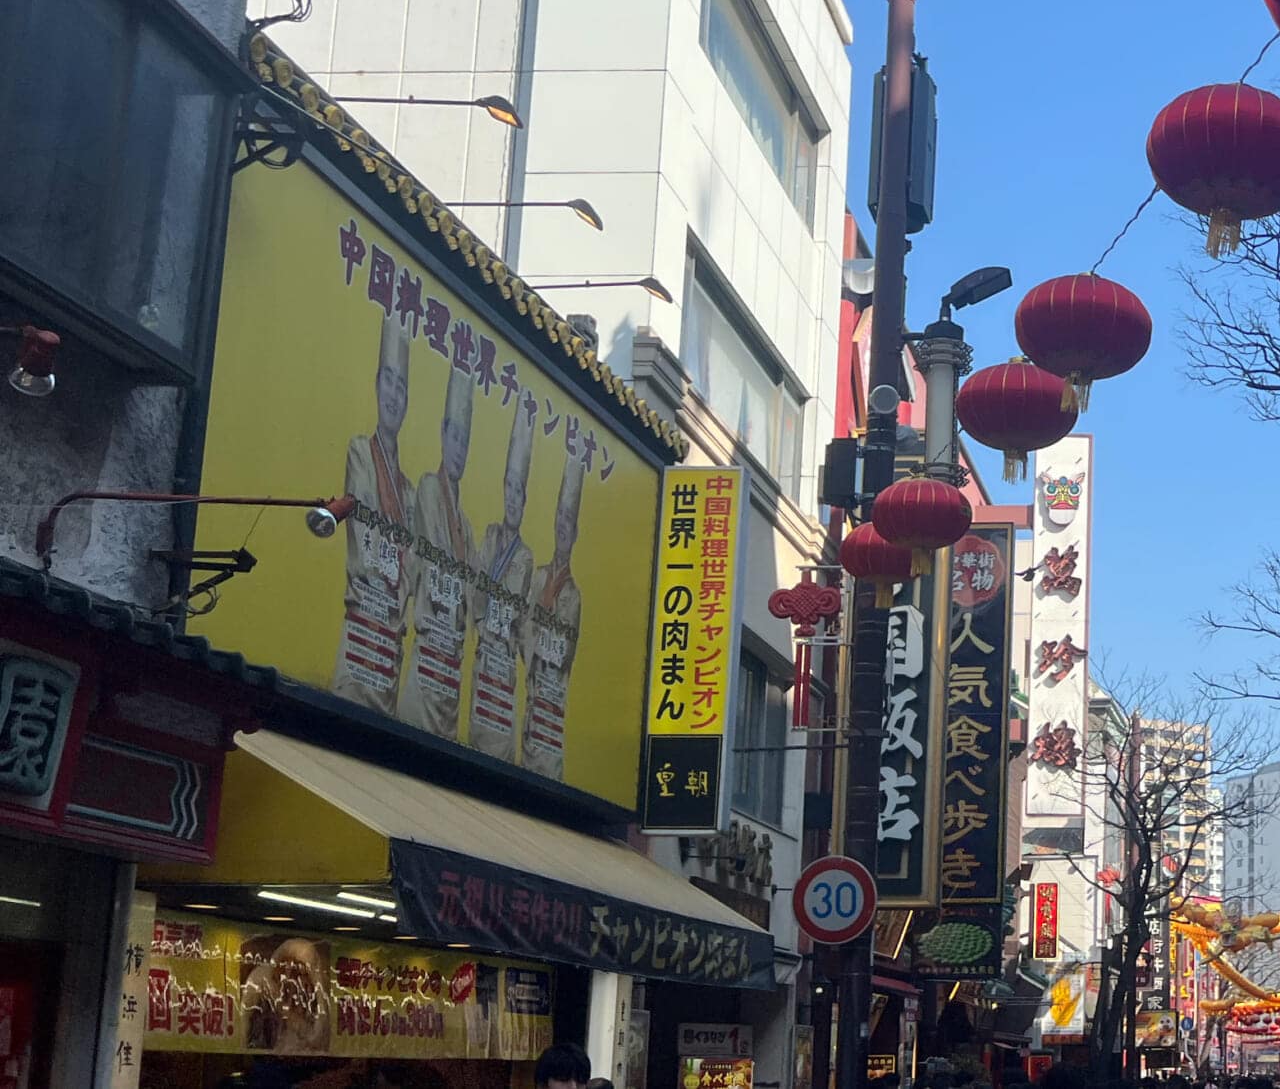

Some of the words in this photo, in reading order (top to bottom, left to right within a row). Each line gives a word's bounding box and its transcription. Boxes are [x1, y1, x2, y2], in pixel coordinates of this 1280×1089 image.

[339, 219, 615, 481] 中国料理世界チャンピオン
[656, 483, 699, 720] 世界一の肉まん
[690, 475, 733, 729] 中国料理世界チャンピオン
[655, 763, 708, 798] 皇朝
[942, 612, 996, 890] 人気食べ歩き
[811, 881, 857, 919] 30
